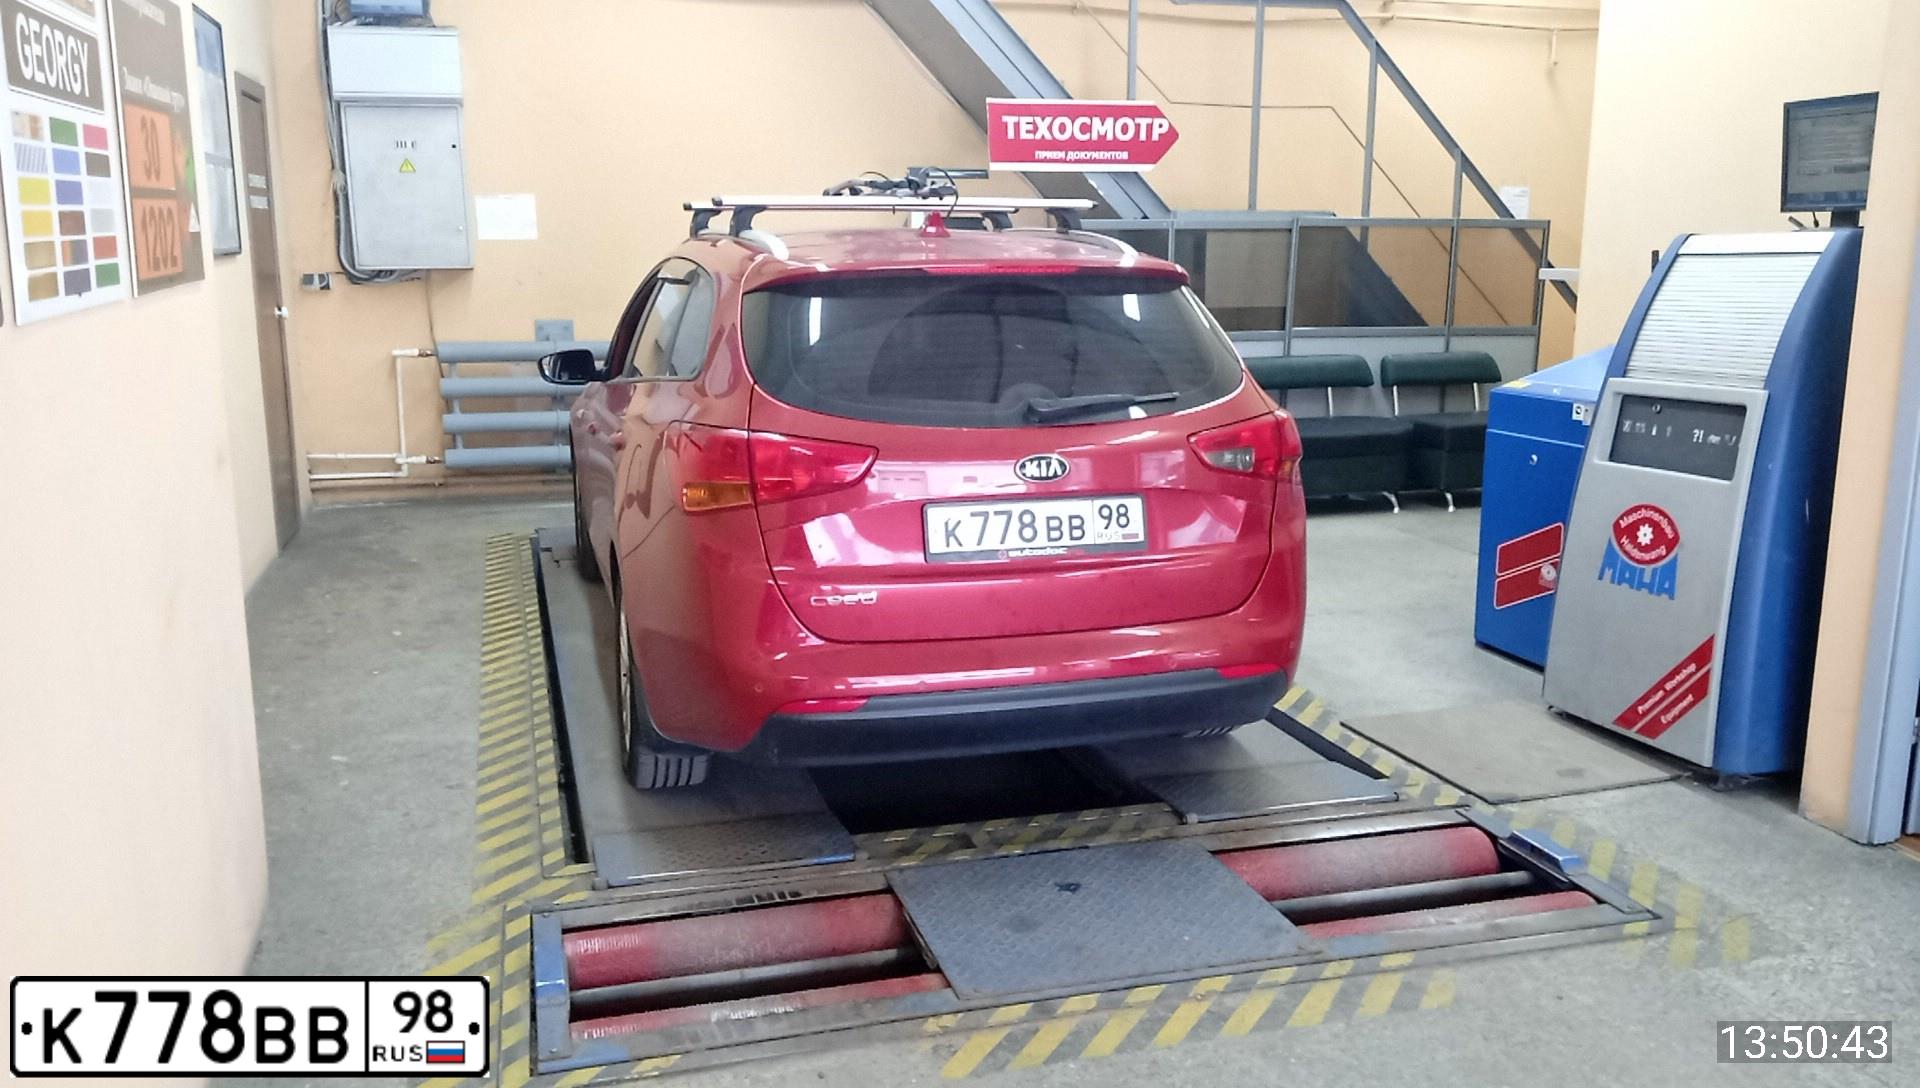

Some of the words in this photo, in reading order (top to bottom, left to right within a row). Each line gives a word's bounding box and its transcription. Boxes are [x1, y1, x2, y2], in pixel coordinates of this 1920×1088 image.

[15, 12, 90, 98] GEORGY
[1001, 114, 1170, 142] ТЕХОСМОТР
[1066, 150, 1129, 162] ДОКУМЕНТОВ
[140, 205, 178, 272] 1202
[1022, 456, 1063, 478] KIA
[1098, 503, 1131, 530] 98
[1597, 537, 1679, 601] MAHA
